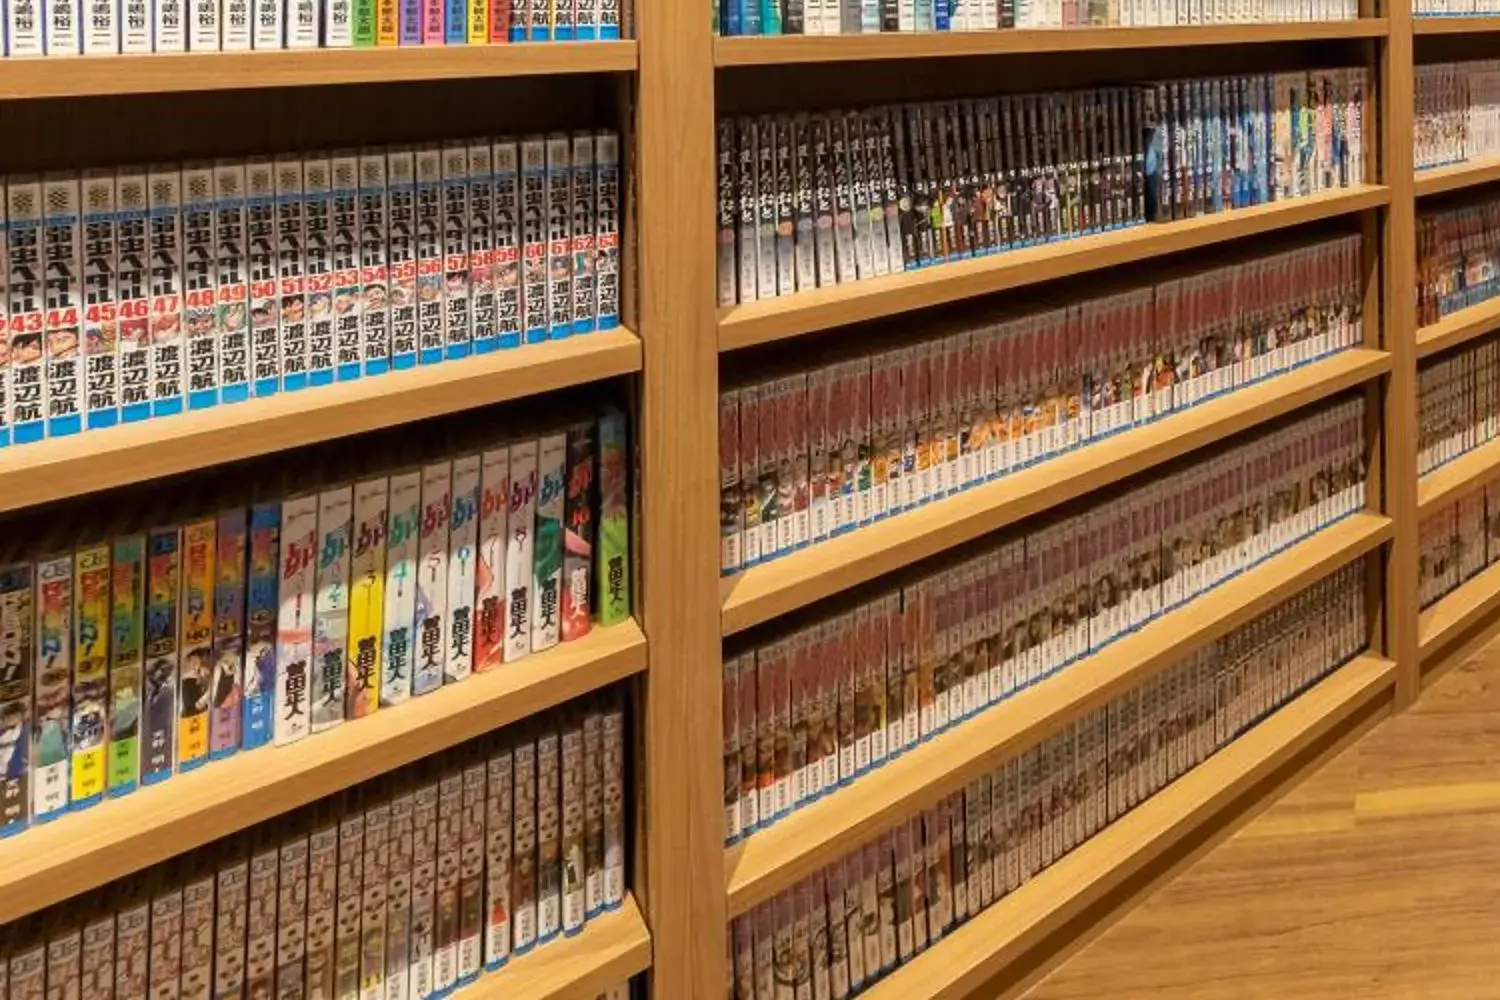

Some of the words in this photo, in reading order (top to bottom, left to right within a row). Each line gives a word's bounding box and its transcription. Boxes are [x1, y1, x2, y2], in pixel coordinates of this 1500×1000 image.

[152, 216, 178, 294] 弱虫ペダル
[188, 212, 212, 289] 弱虫ペダル
[220, 210, 242, 284] 弱虫ペダル
[251, 205, 274, 280] 弱虫ペダル
[280, 204, 301, 276] 弱虫ペダル
[308, 201, 328, 274] 弱虫ペダル
[336, 198, 356, 270] 弱虫ペダル
[495, 248, 518, 262] 59
[526, 244, 544, 258] 60
[552, 240, 568, 254] 61
[576, 236, 592, 251] 62
[600, 234, 617, 248] 63
[11, 228, 40, 312] 弱虫ペダル
[47, 226, 77, 308] 弱虫ペダル
[86, 222, 115, 303] 弱虫ペダル
[120, 218, 147, 299] 弱虫ペダル
[336, 271, 358, 286] 53
[363, 268, 385, 283] 54
[392, 264, 415, 278] 55
[420, 260, 440, 274] 56
[448, 255, 466, 270] 57
[472, 252, 493, 266] 58
[153, 295, 179, 313] 47
[188, 290, 214, 307] 48
[219, 285, 246, 302] 49
[252, 281, 275, 298] 50
[282, 278, 304, 294] 51
[309, 275, 332, 291] 52
[11, 314, 42, 333] 43
[48, 308, 78, 328] 44
[86, 304, 116, 322] 45
[120, 300, 148, 317] 46
[222, 334, 246, 382] 渡辺航
[255, 328, 277, 377] 渡辺航
[284, 324, 304, 372] 渡辺航
[310, 321, 332, 368] 渡辺航
[338, 316, 358, 362] 渡辺航
[88, 356, 115, 408] 渡辺航
[123, 351, 148, 403] 渡辺航
[156, 346, 181, 396] 渡辺航
[190, 339, 215, 389] 渡辺航
[14, 366, 42, 421] 渡辺航
[50, 361, 78, 416] 渡辺航
